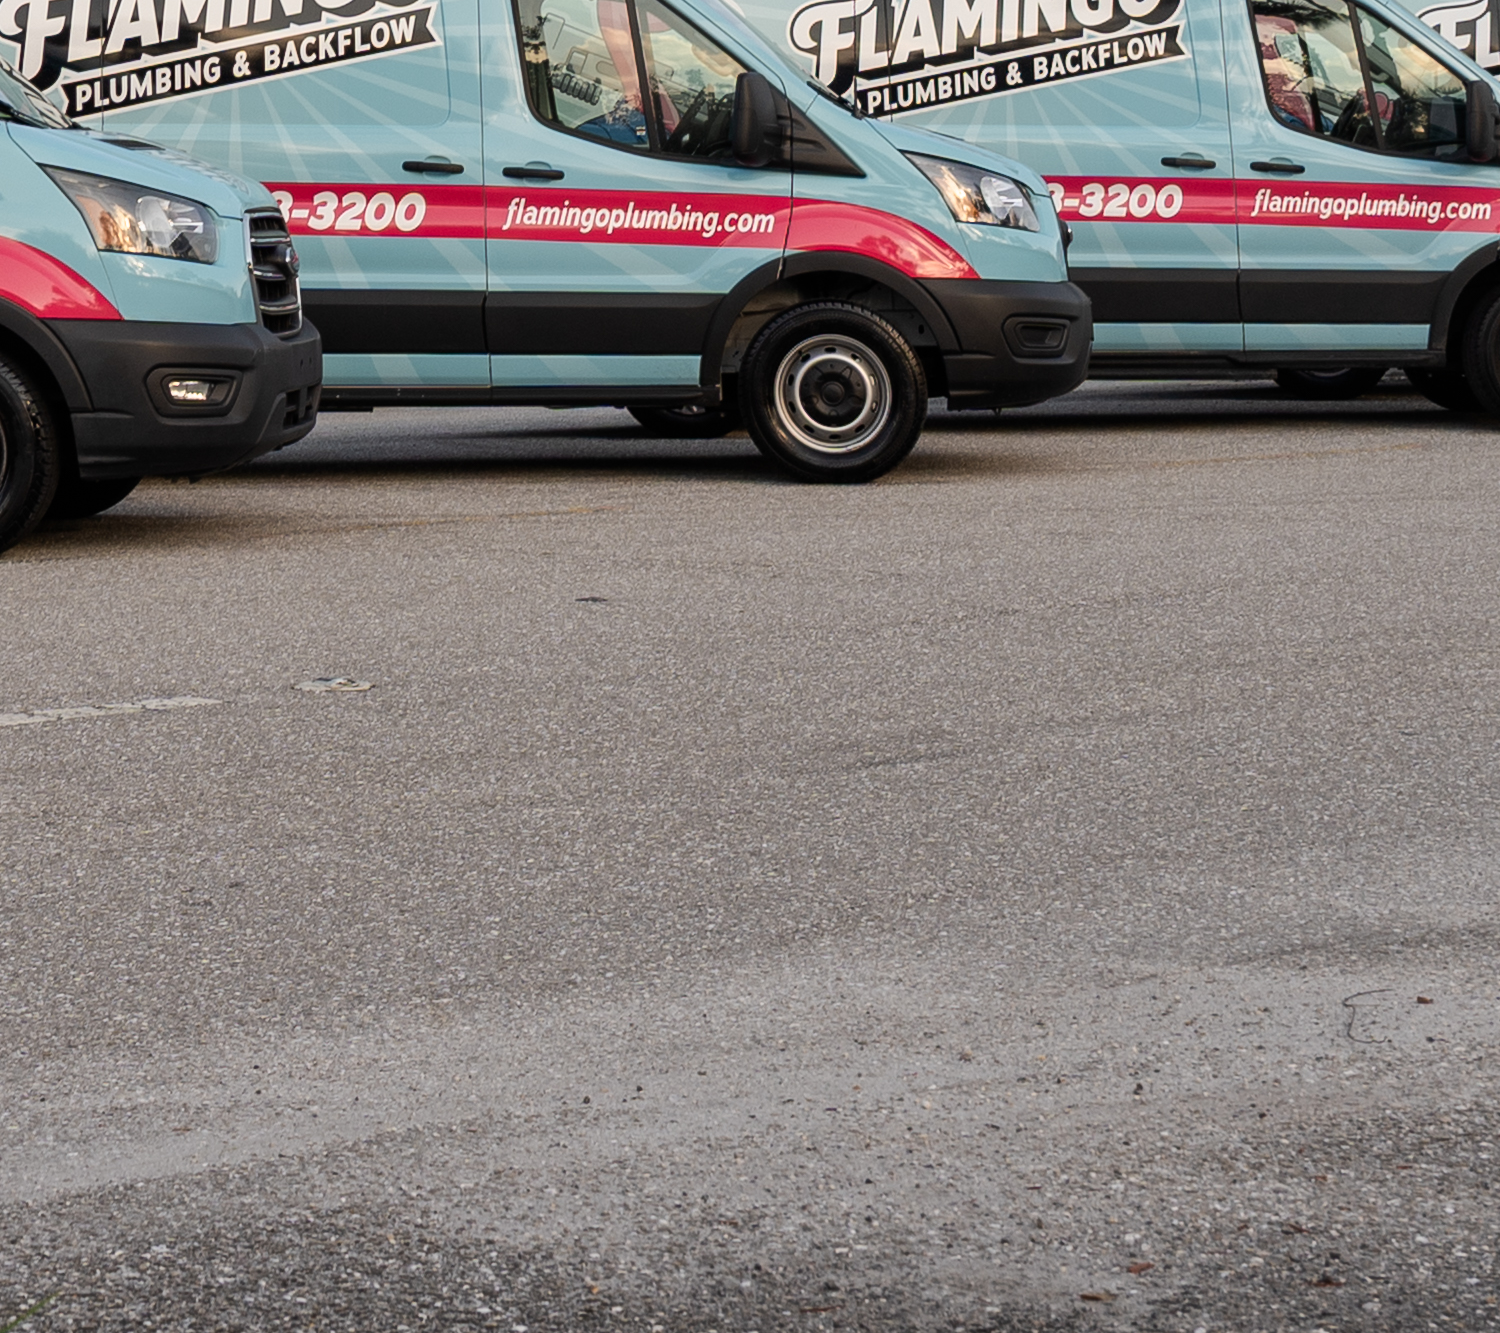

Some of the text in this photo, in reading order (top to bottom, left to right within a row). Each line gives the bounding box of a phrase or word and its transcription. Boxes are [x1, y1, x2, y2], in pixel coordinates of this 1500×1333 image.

[75, 14, 418, 112] PLUMBING & BACKFLOW
[866, 31, 1168, 115] PLUMBING & BACKFLOW
[502, 197, 775, 238] flamingoplumbing.com
[1250, 189, 1491, 224] flamingoplumbing.com
